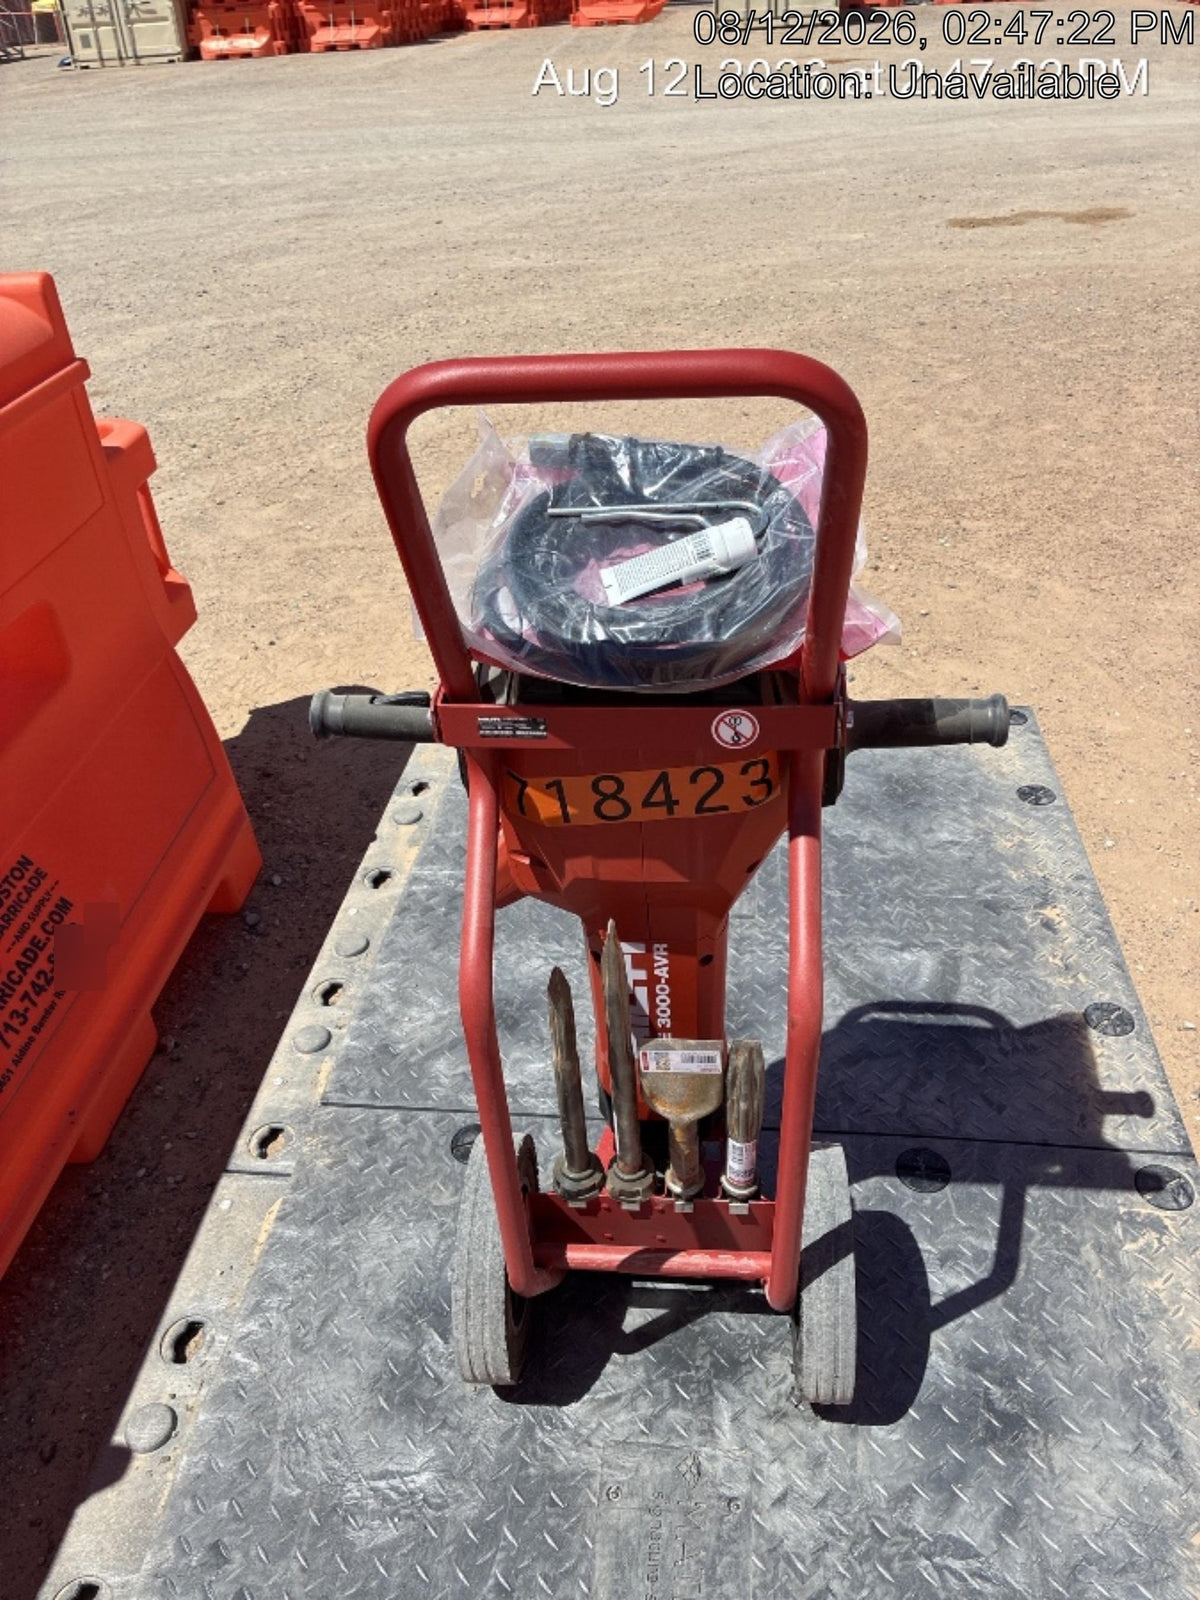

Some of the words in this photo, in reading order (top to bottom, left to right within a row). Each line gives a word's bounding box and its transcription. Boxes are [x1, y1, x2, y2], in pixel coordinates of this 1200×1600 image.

[507, 757, 774, 824] 718423
[0, 854, 34, 909] STON
[653, 943, 671, 1028] 3000-AVR
